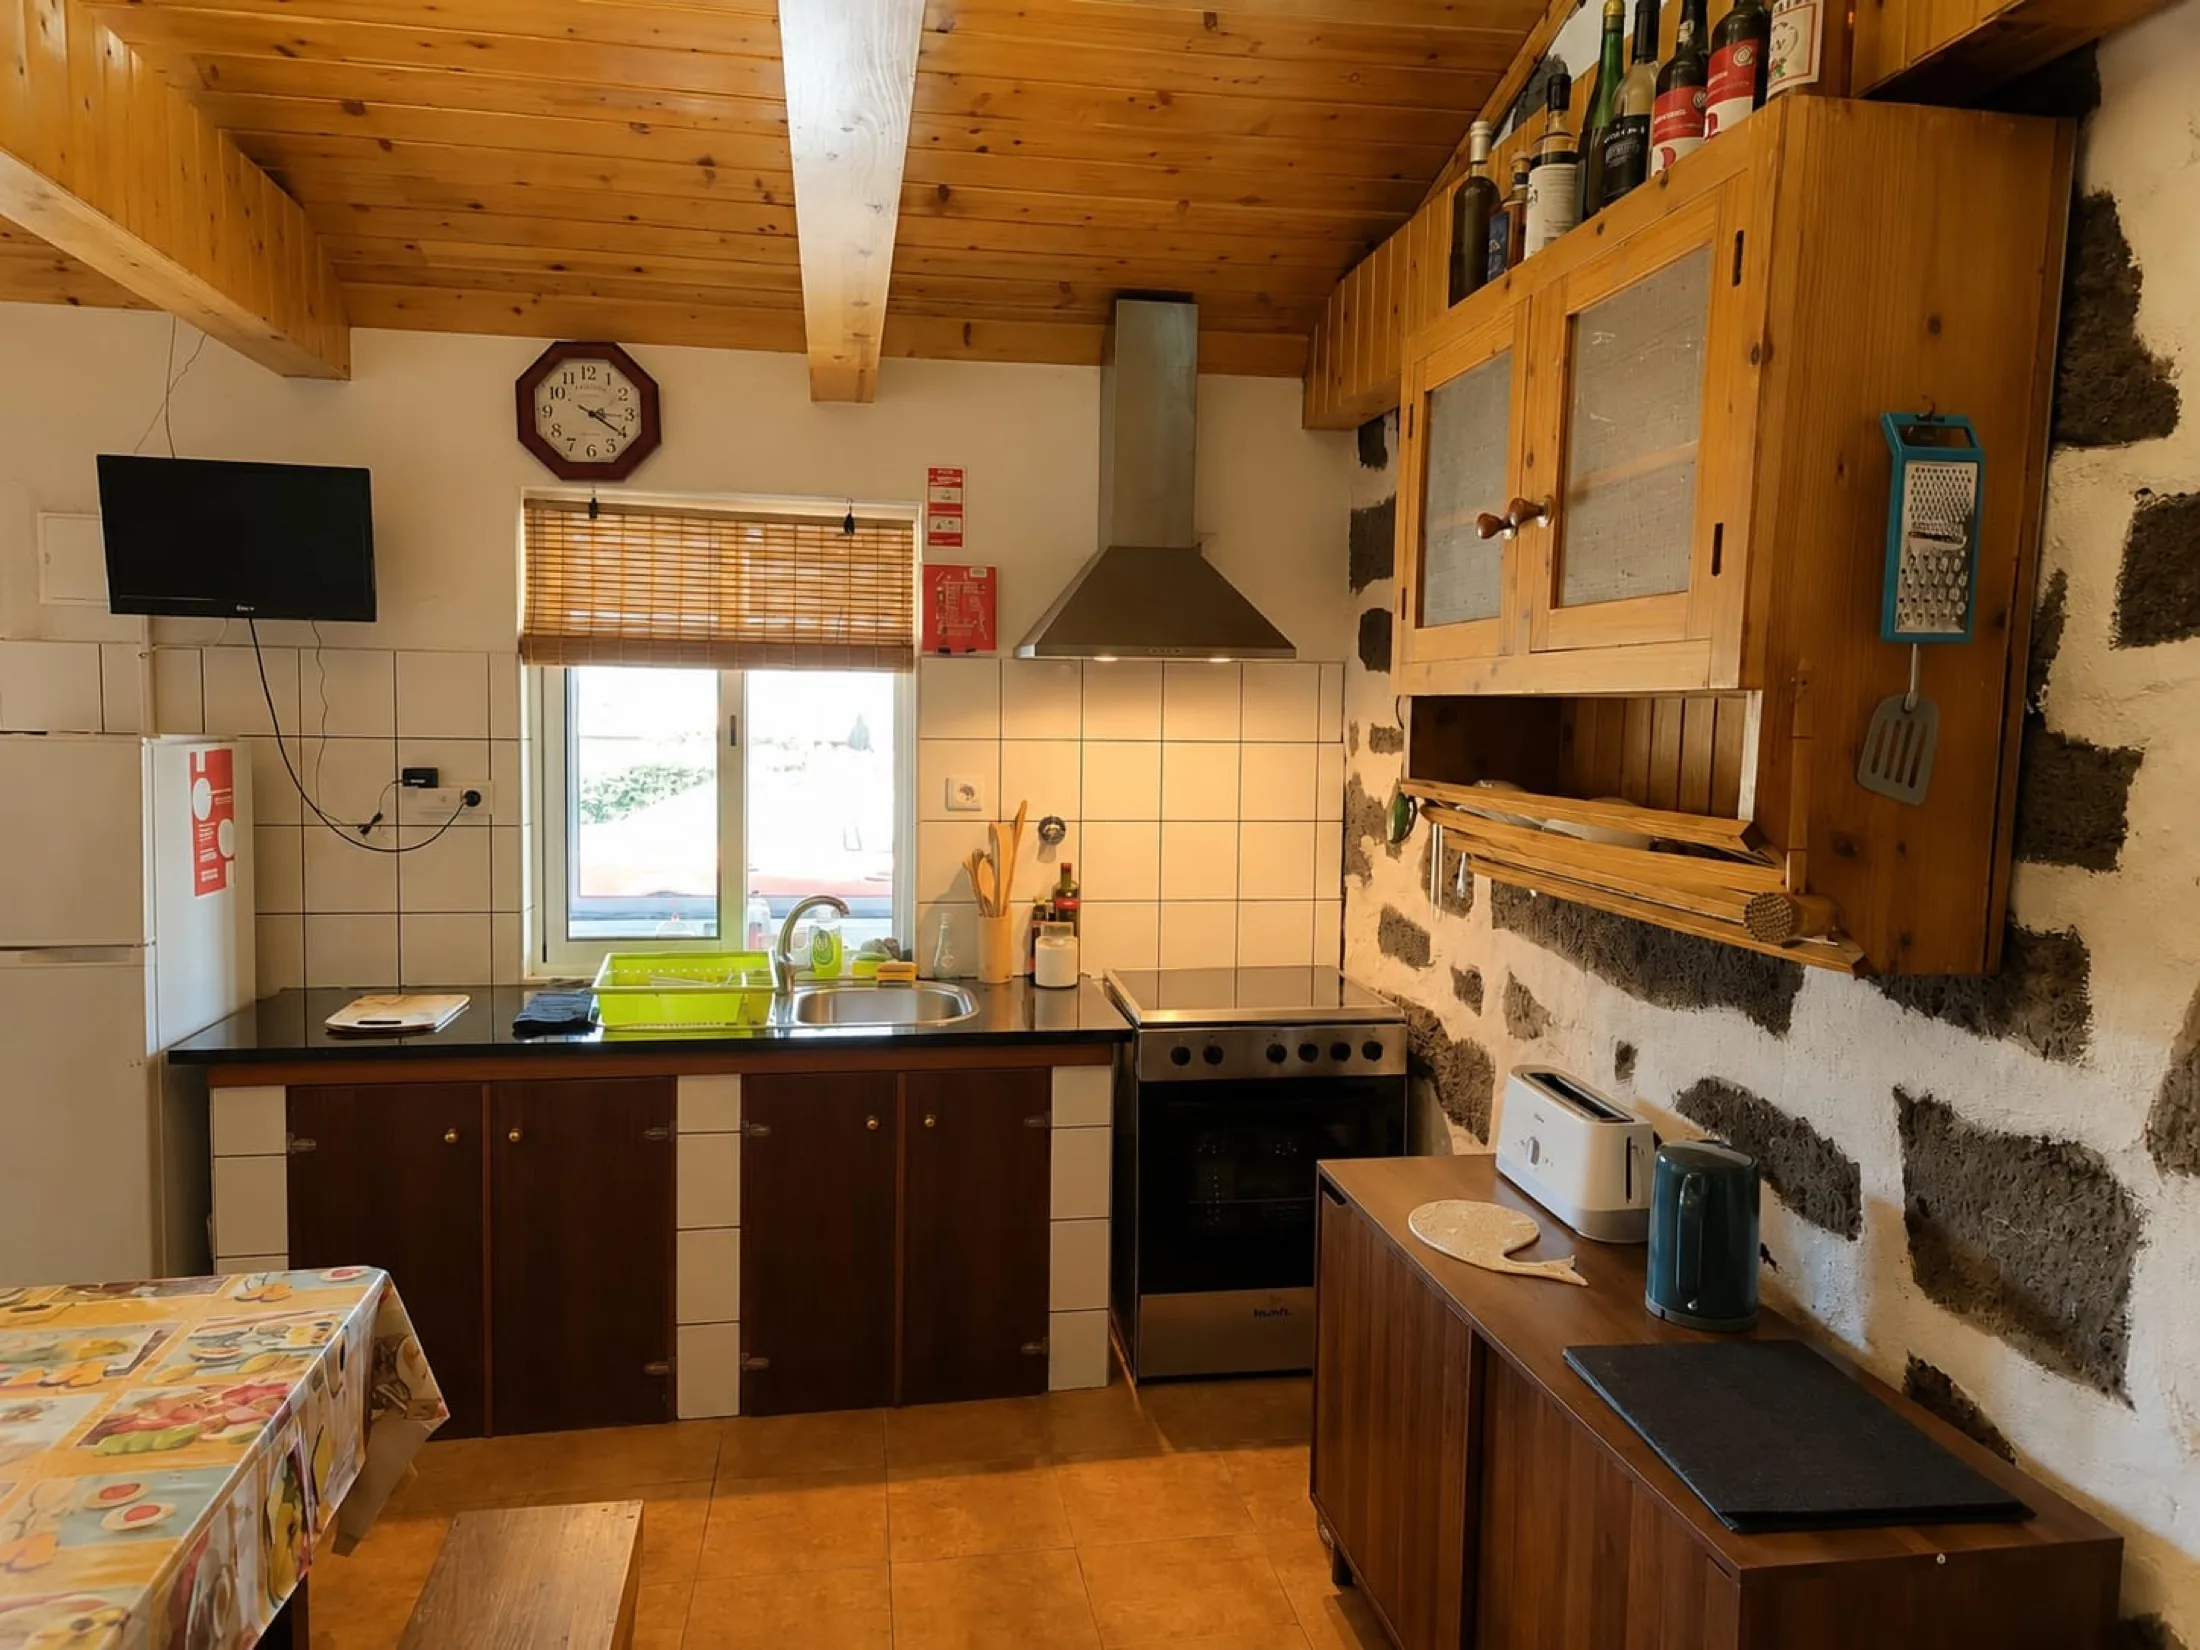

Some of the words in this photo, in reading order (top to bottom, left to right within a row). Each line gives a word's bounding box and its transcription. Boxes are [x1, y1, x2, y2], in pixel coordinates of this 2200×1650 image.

[563, 372, 575, 385] 11
[581, 365, 597, 381] 12
[549, 386, 566, 401] 10
[618, 388, 629, 401] 2
[542, 404, 553, 419] 9
[624, 407, 635, 421] 3
[551, 424, 562, 438] 8
[618, 425, 627, 438] 4
[566, 437, 576, 452] 7
[586, 444, 597, 458] 6
